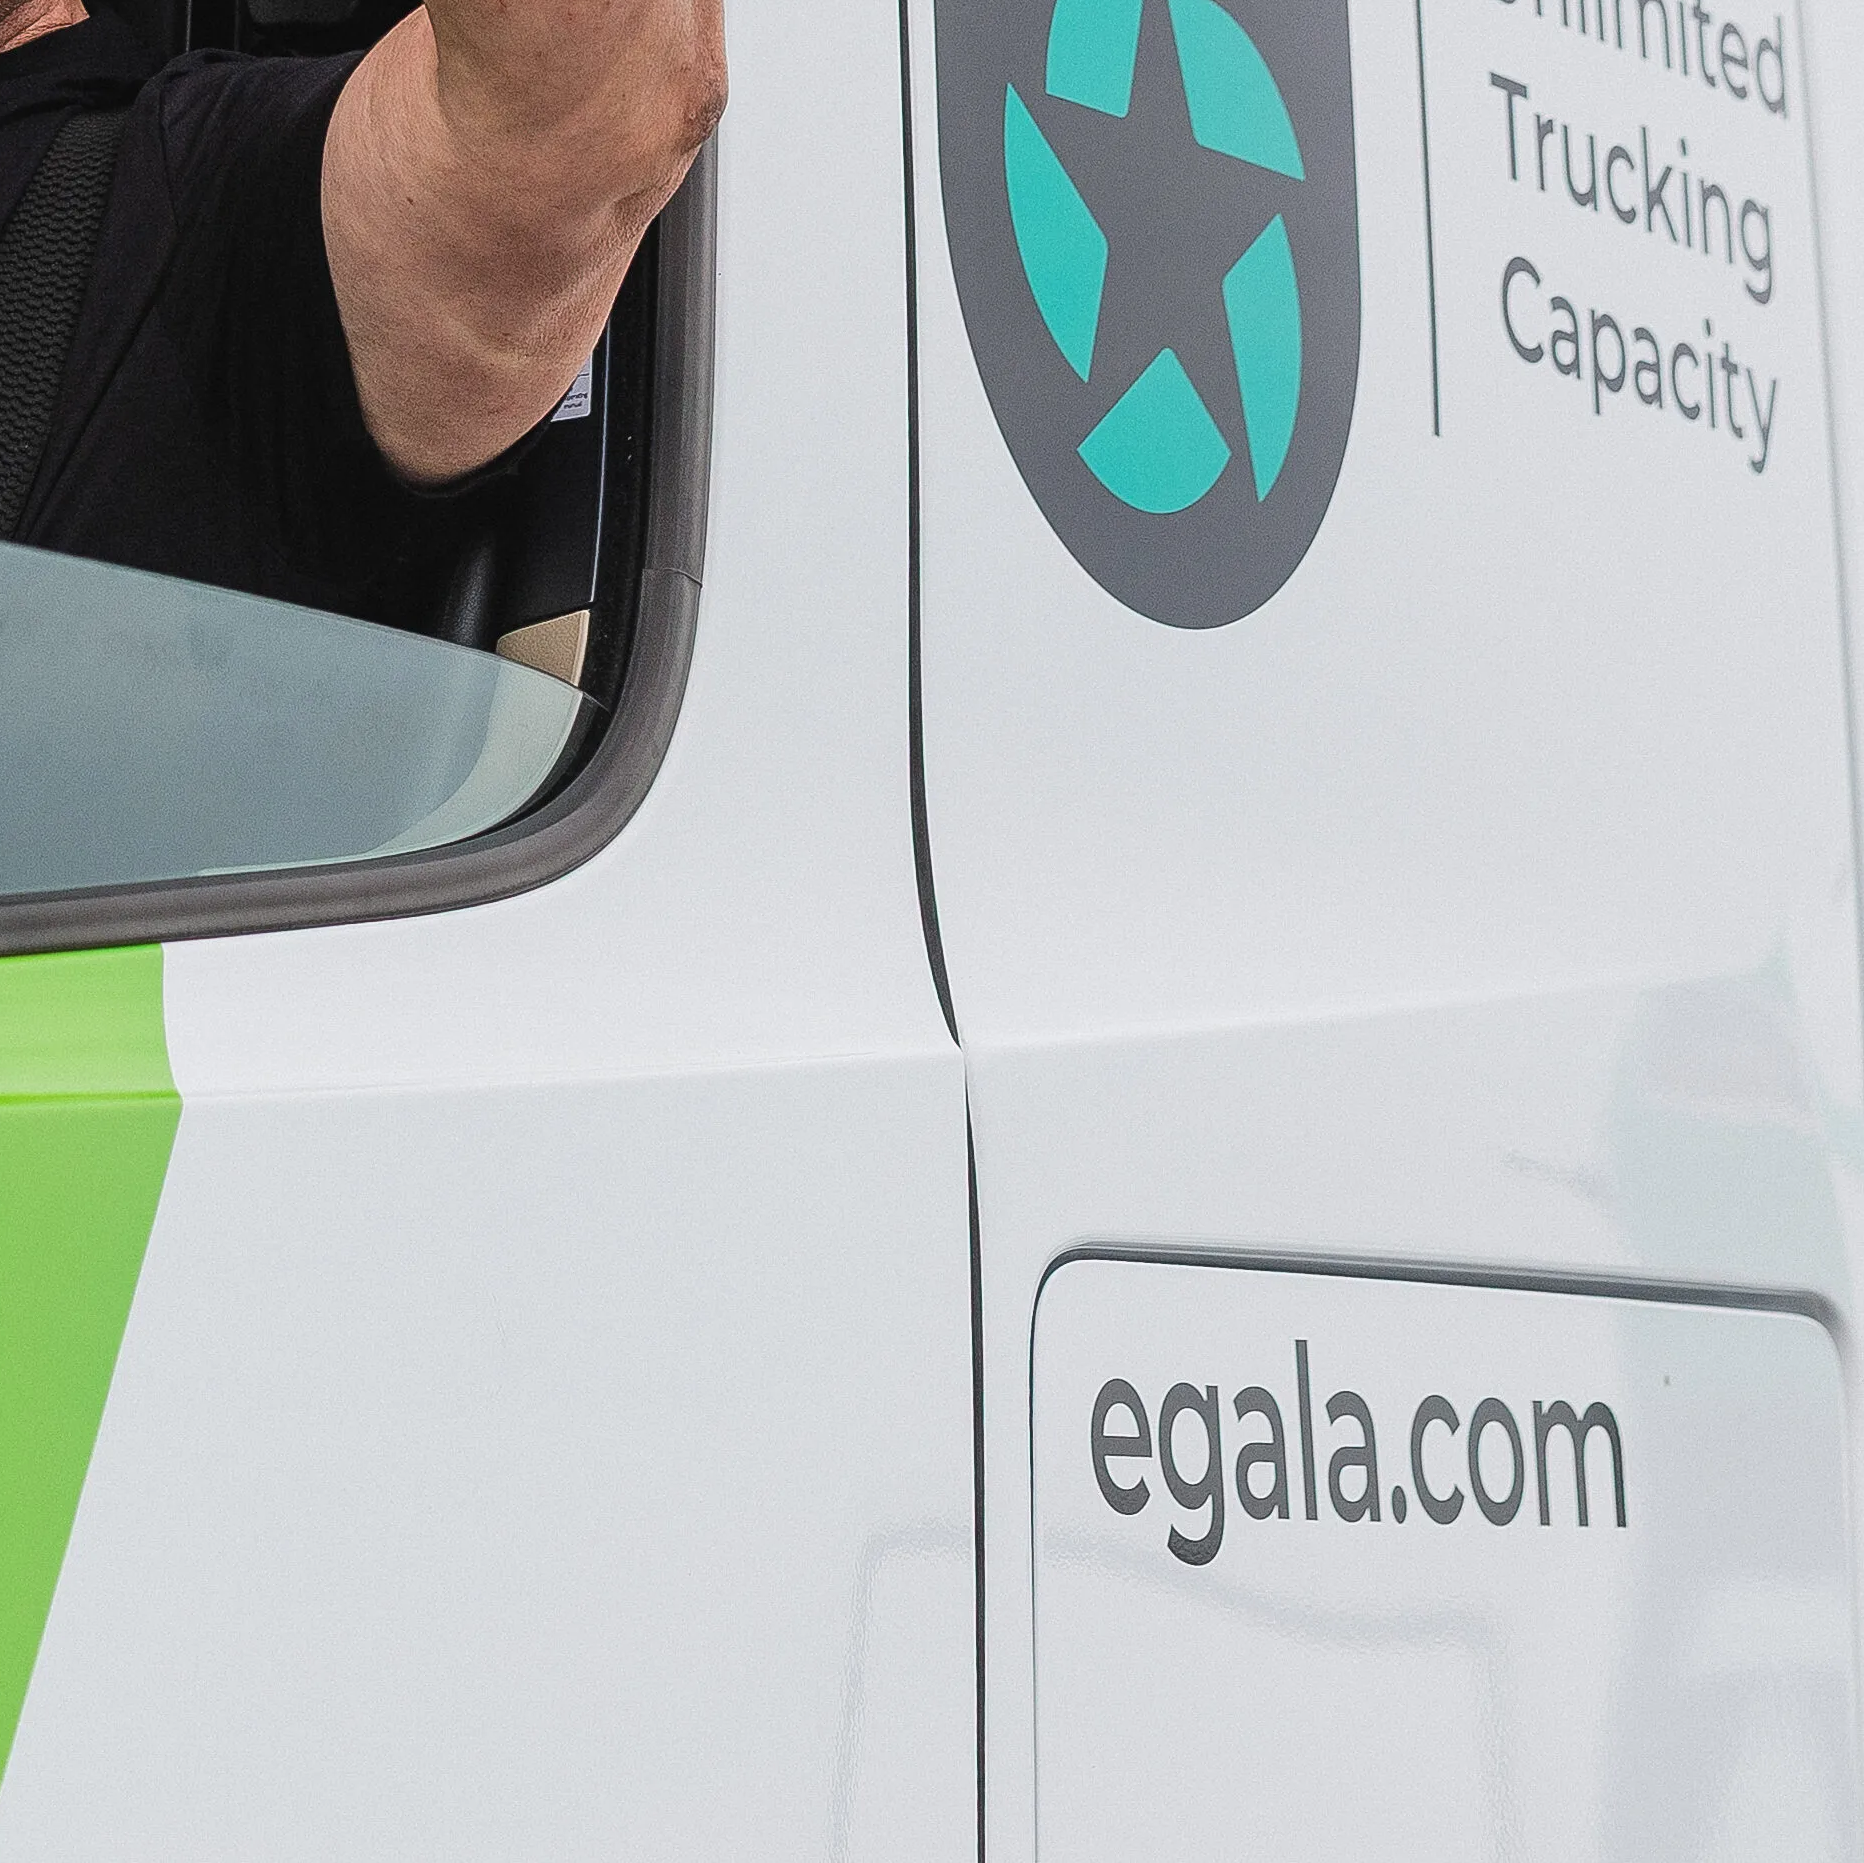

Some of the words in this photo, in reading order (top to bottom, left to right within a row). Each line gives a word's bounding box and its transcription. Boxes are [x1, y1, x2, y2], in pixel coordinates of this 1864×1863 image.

[1489, 71, 1774, 306] Trucking
[1500, 255, 1778, 476] Capacity
[1090, 1338, 1628, 1567] egala.com
